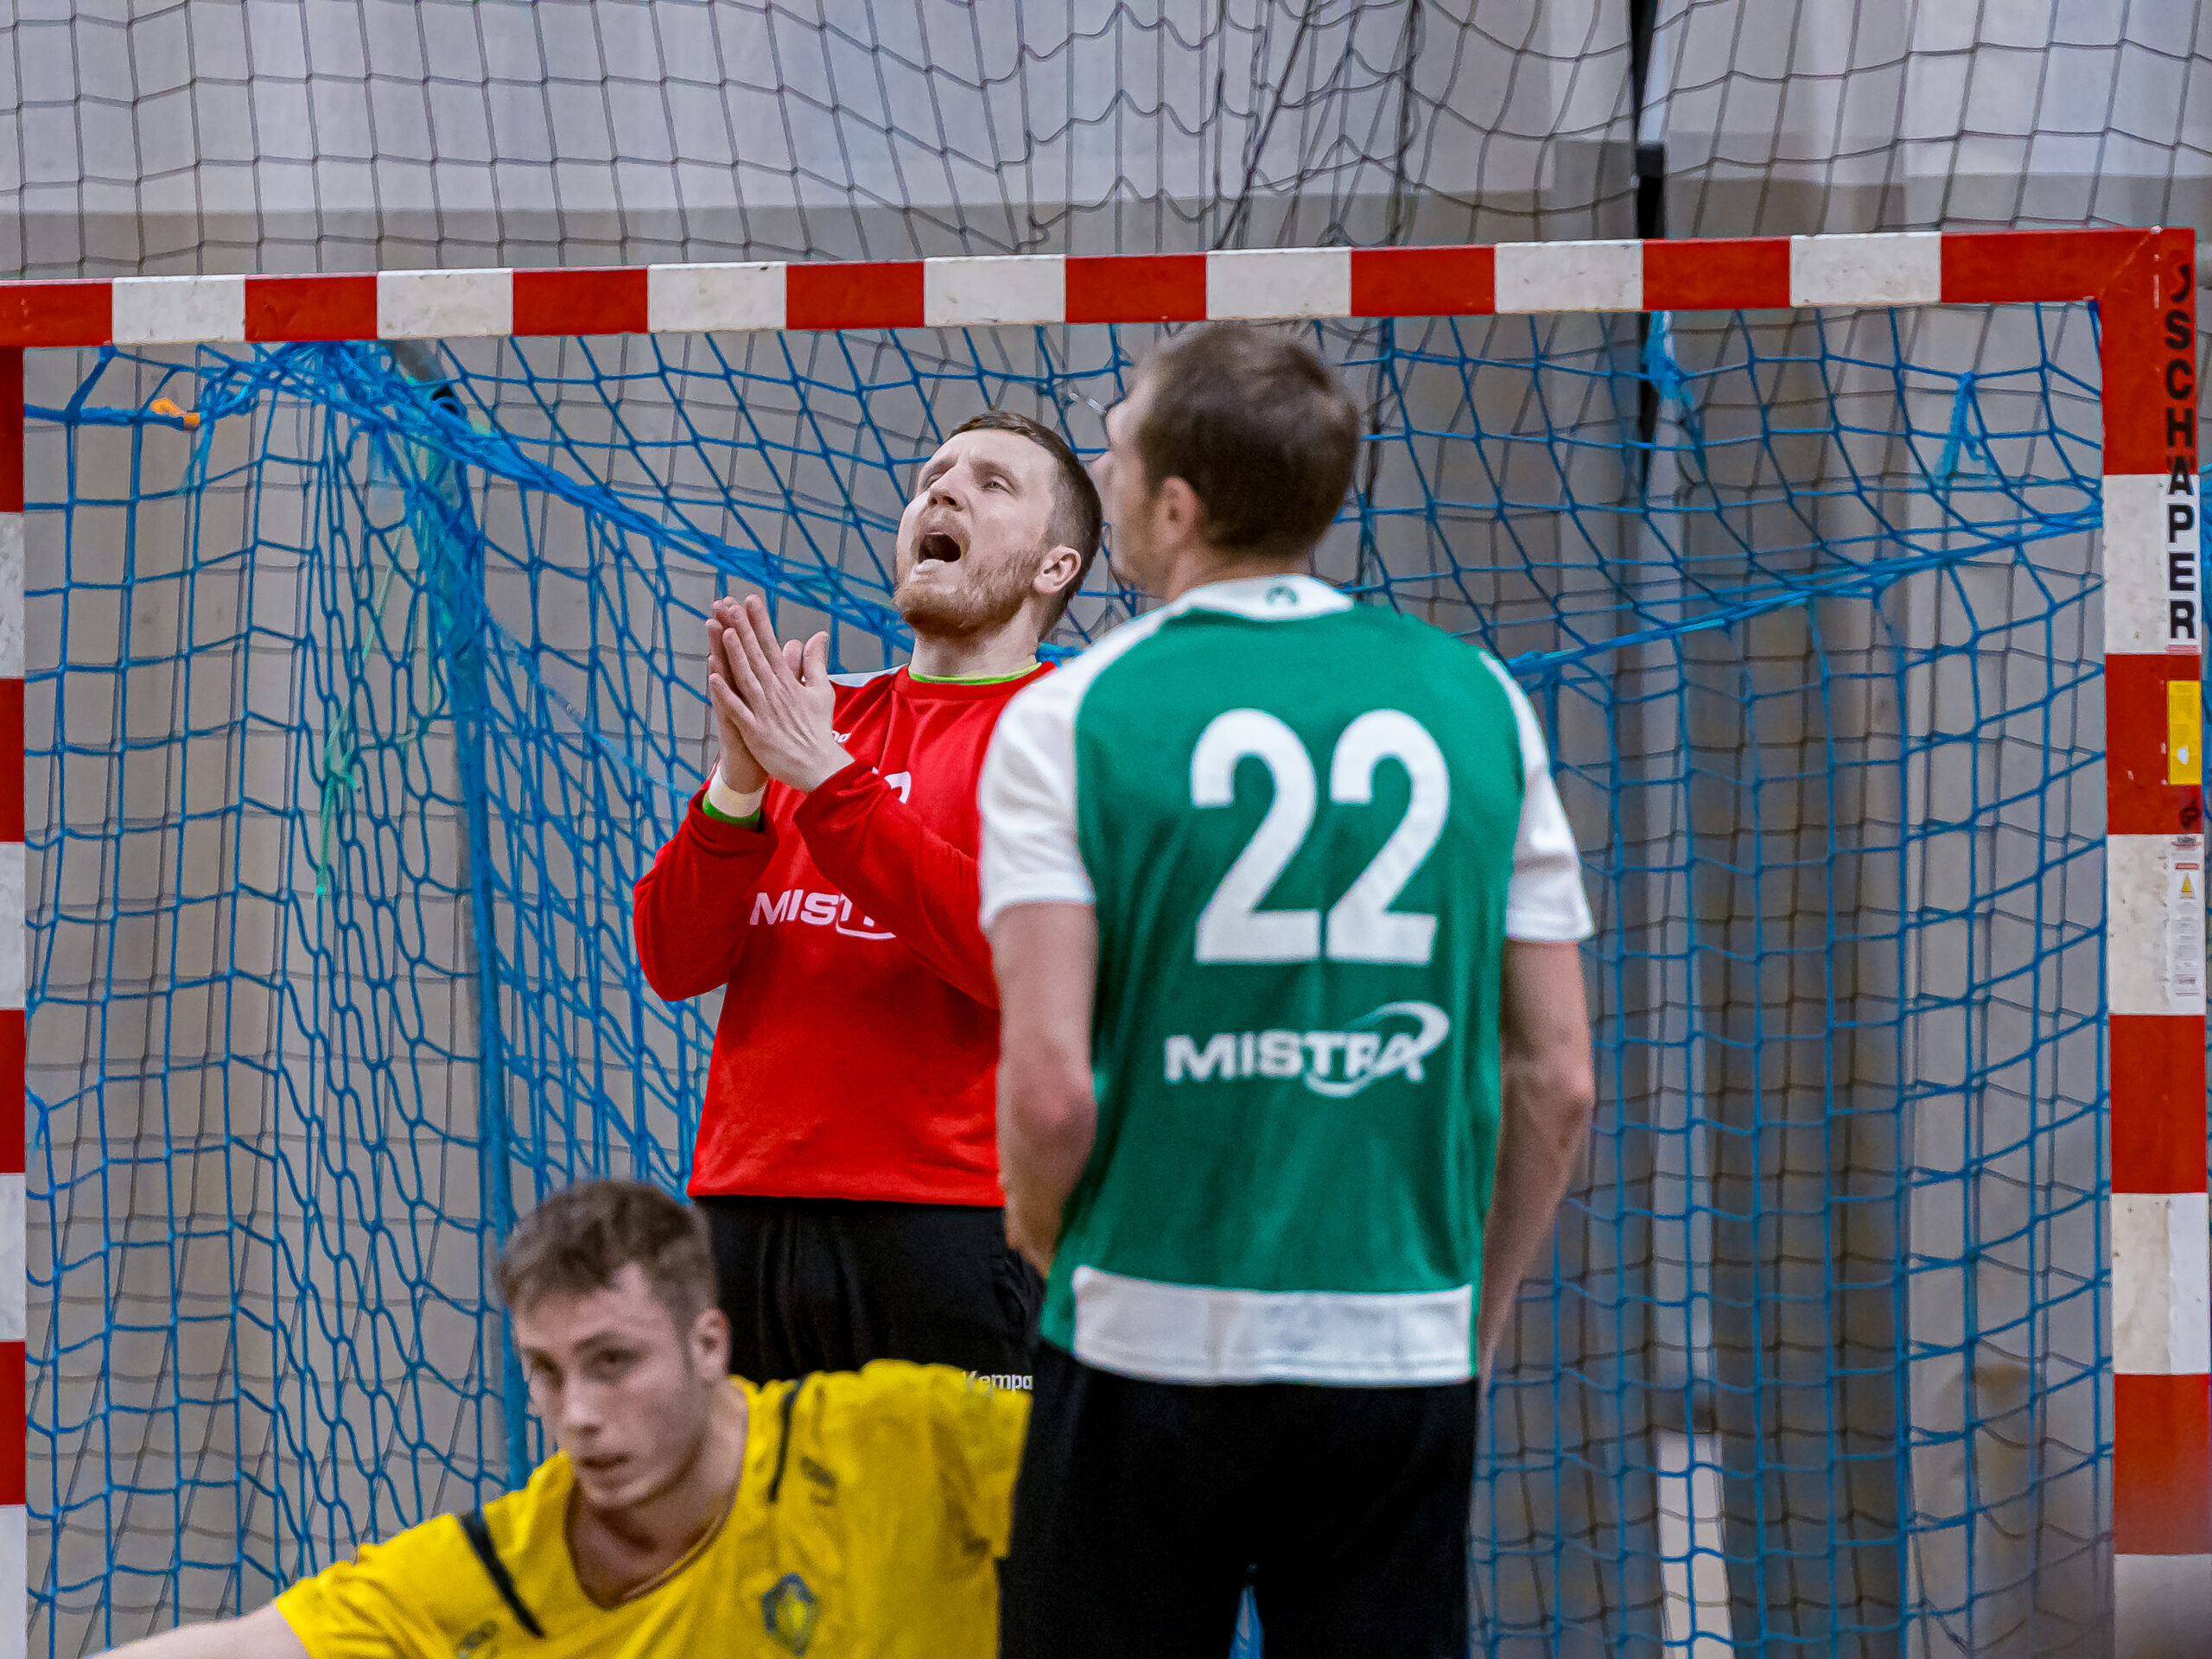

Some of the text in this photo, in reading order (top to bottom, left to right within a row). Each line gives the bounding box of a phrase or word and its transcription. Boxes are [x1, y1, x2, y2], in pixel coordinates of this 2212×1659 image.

[1190, 708, 1451, 966] 22
[749, 889, 883, 931] MIST
[1164, 1011, 1445, 1094] MISTRA
